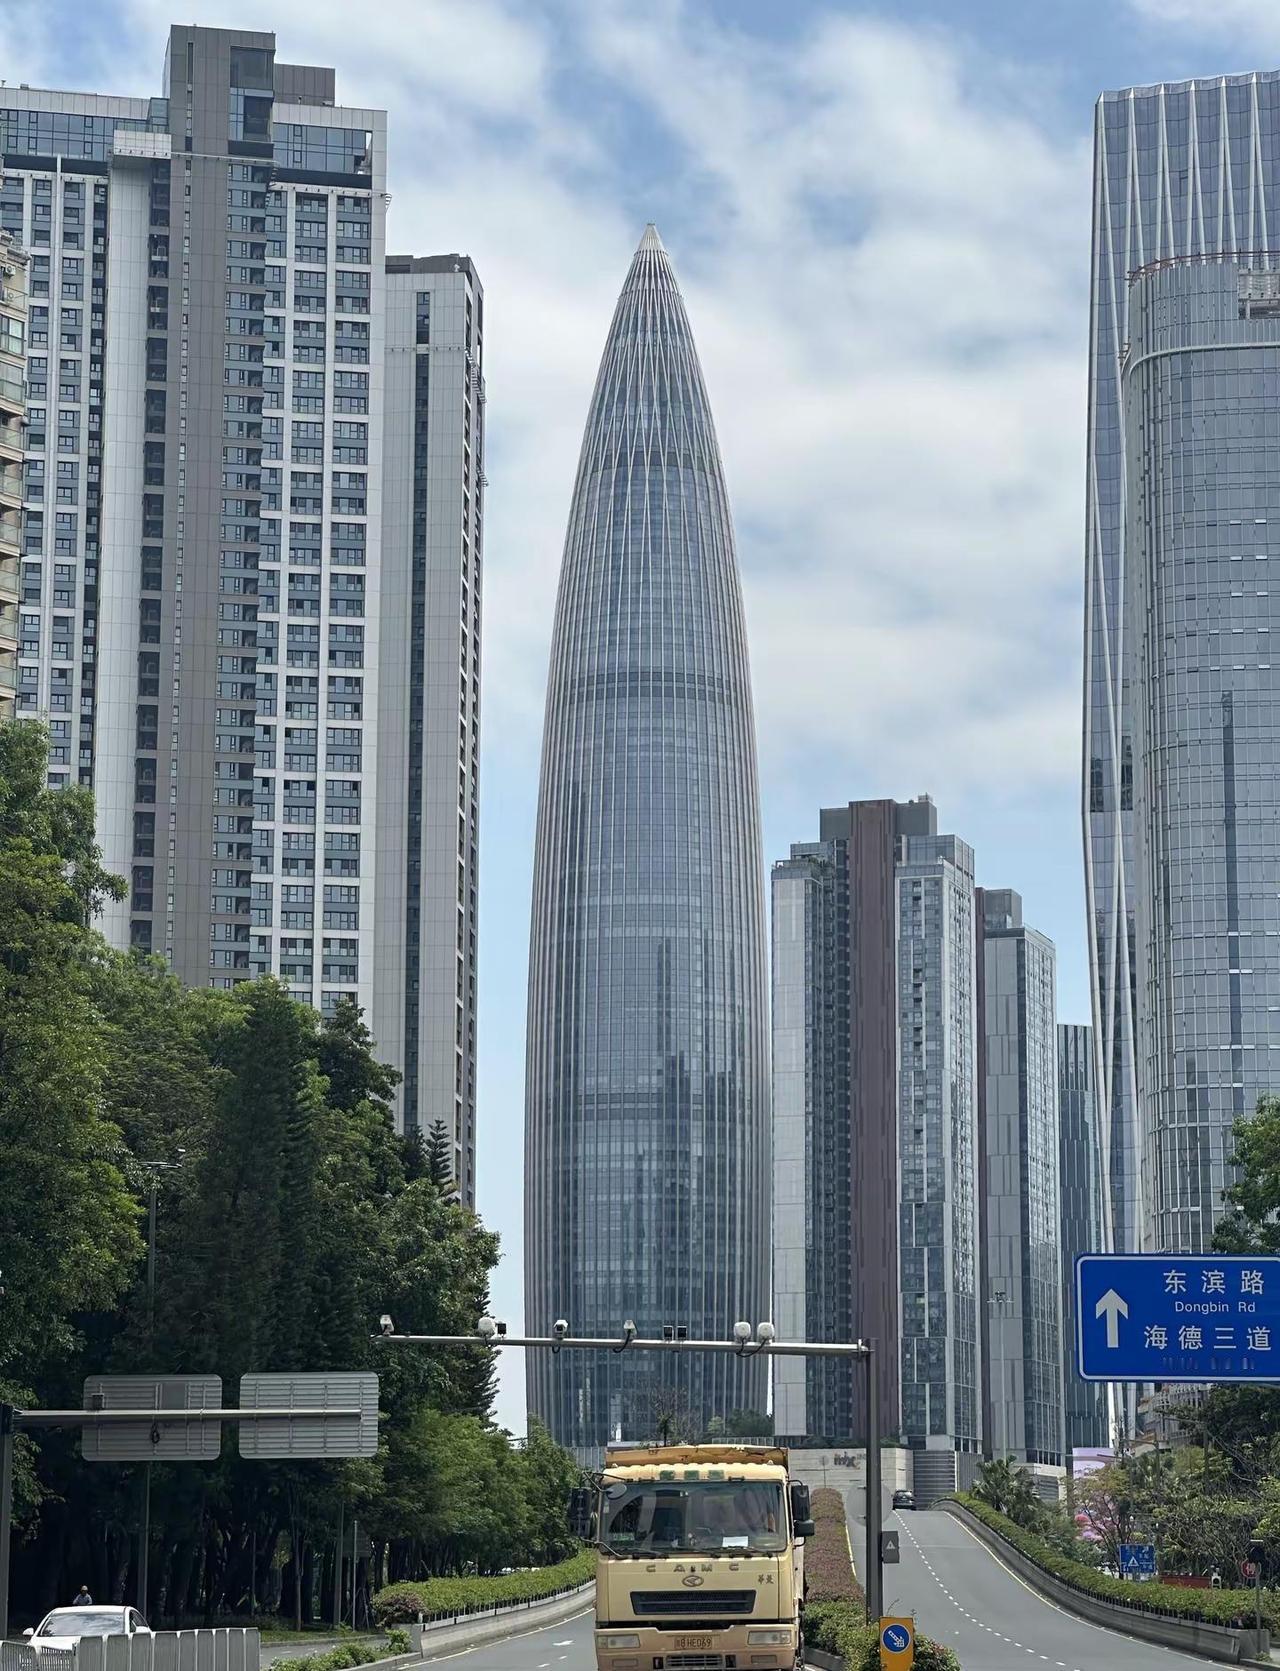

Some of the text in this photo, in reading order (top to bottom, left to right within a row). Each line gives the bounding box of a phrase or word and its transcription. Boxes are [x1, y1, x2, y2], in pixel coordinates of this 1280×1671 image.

[1163, 1269, 1265, 1295] 东滨路
[1175, 1301, 1256, 1315] Dongbin Rd
[1143, 1324, 1272, 1351] 海德三道
[646, 1563, 740, 1573] CAMC
